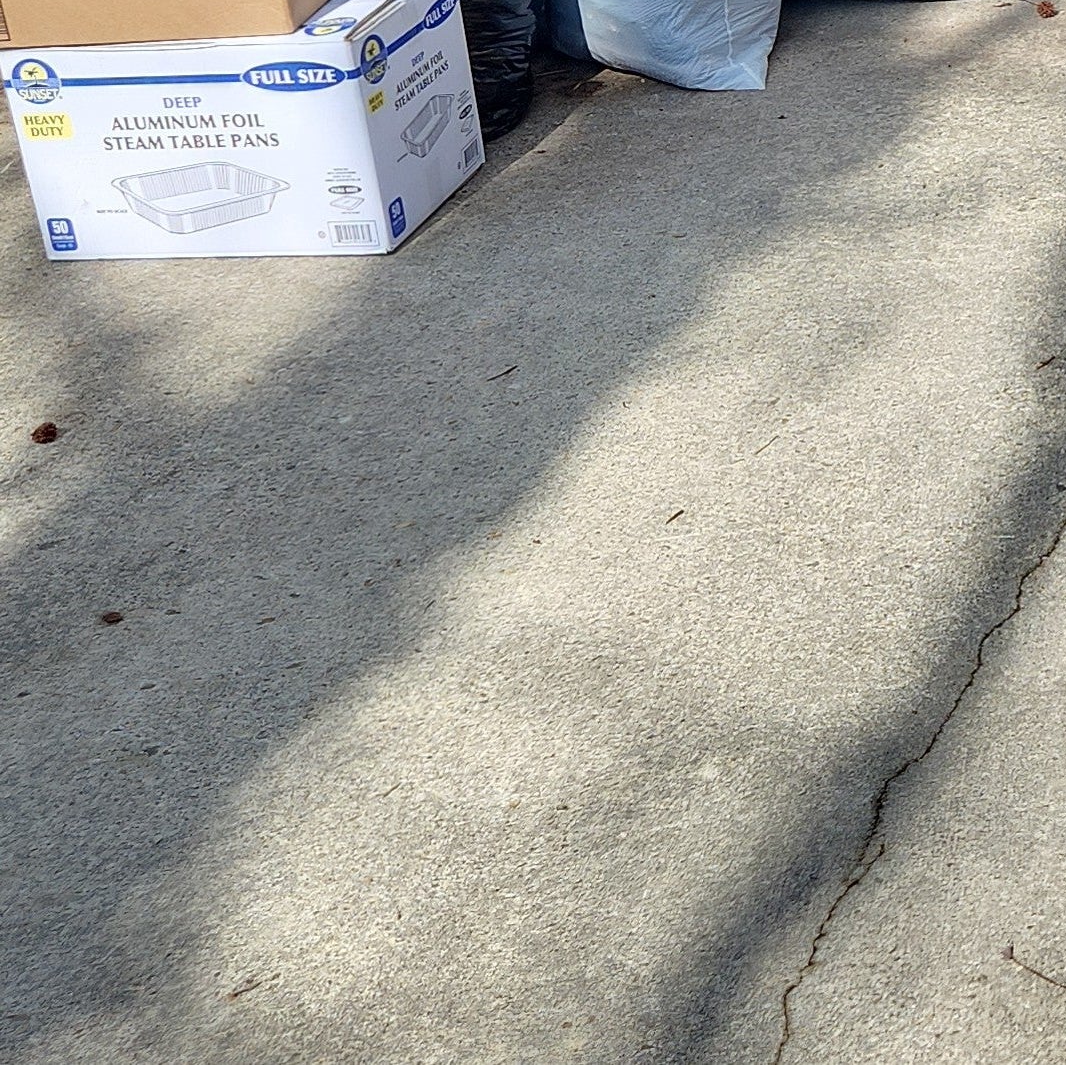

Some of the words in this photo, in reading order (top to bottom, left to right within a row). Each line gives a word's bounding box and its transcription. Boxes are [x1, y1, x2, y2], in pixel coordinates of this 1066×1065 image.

[426, 8, 443, 27] FULL
[249, 69, 295, 85] FULL
[297, 68, 338, 83] SIZE
[396, 60, 430, 94] ALUMINUM
[430, 50, 444, 66] FOIL
[394, 87, 417, 111] STEAM
[416, 72, 435, 94] TABLE
[433, 60, 449, 80] PANS
[20, 88, 59, 101] SUNSET
[163, 96, 202, 109] DEEP
[24, 115, 65, 126] HEAVY
[112, 114, 217, 131] ALUMINUM
[221, 113, 265, 128] FOIL
[30, 127, 64, 137] DUTY
[103, 136, 165, 151] STEAM
[168, 134, 227, 150] TABLE
[231, 133, 280, 148] PANS
[51, 220, 69, 234] 50
